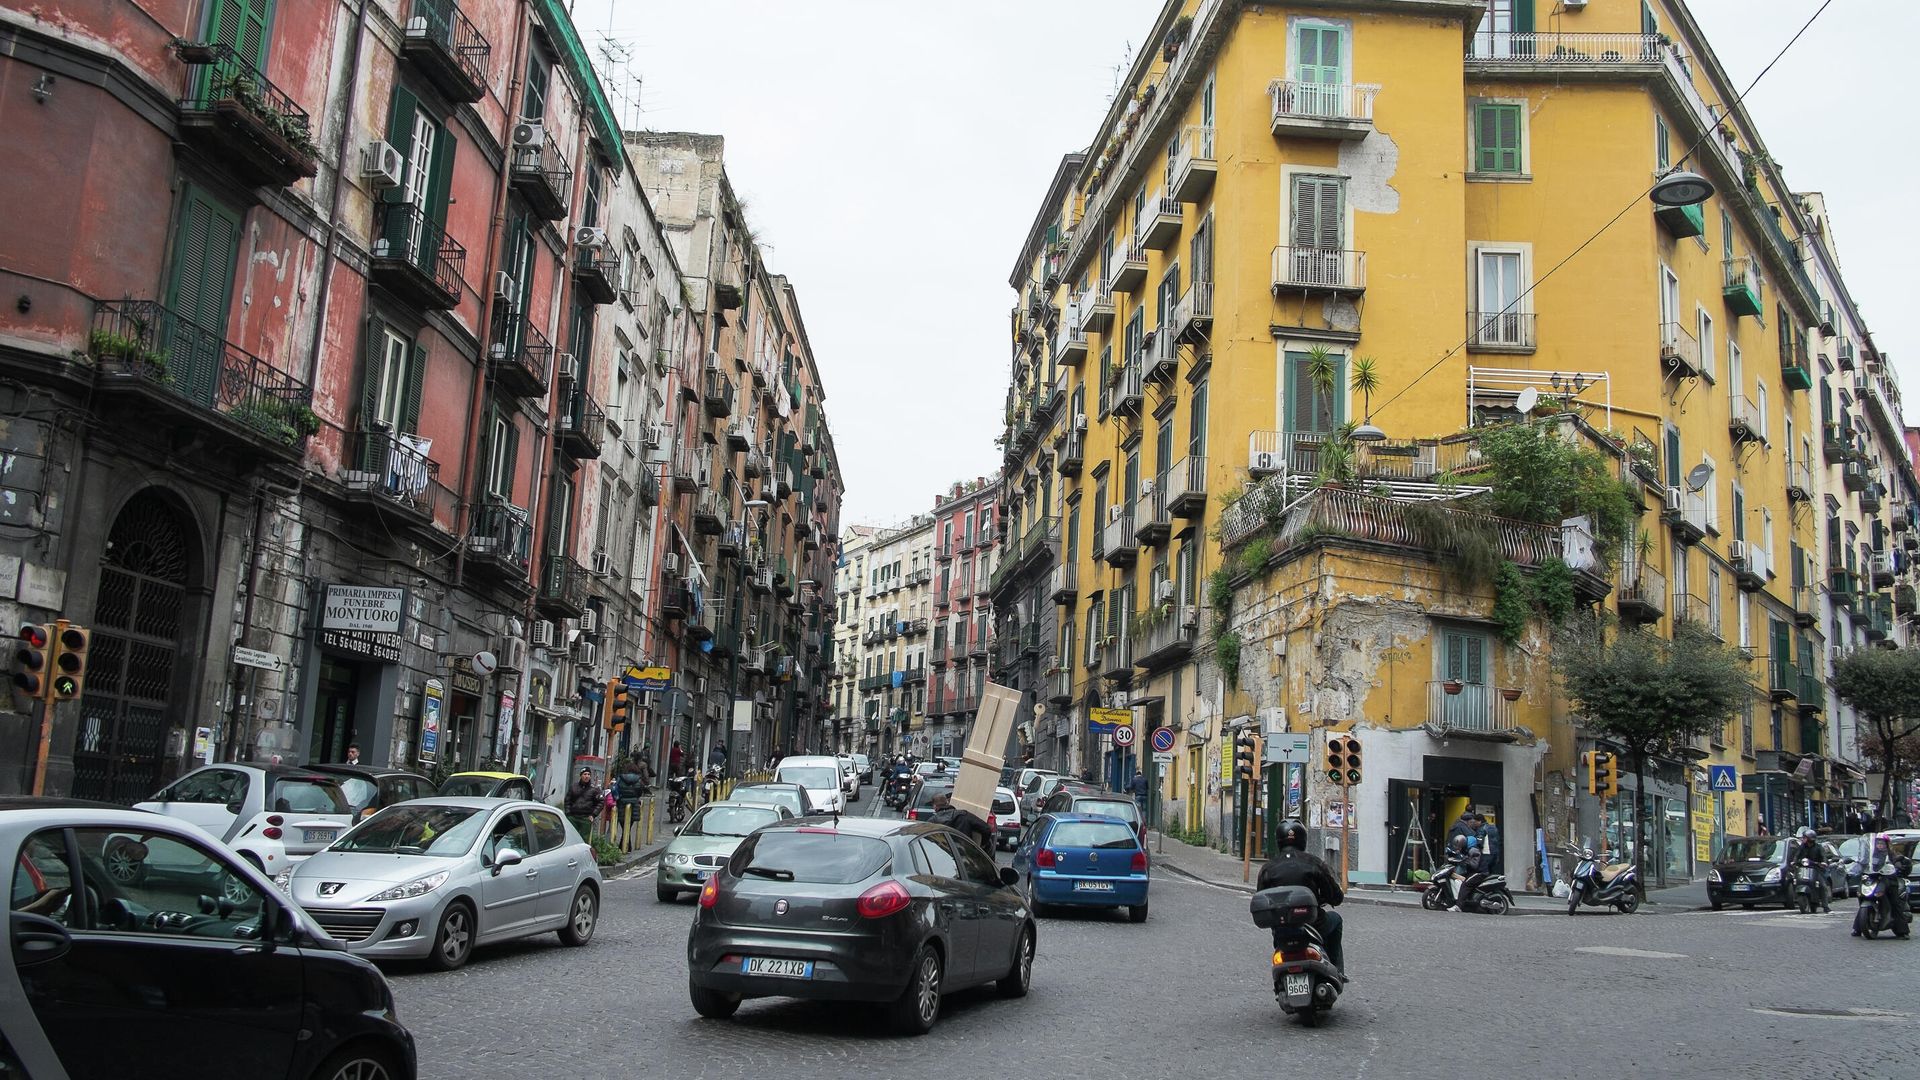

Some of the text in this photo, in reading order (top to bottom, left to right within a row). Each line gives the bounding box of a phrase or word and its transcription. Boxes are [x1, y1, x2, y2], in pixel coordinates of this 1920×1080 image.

[328, 587, 402, 600] PRIMARIA IMPRESA
[343, 598, 386, 608] FUNEBRE
[326, 606, 398, 623] MONTUORO
[324, 632, 337, 646] TEL
[339, 636, 370, 654] 5640892
[455, 673, 480, 692] MUSEO
[1118, 730, 1131, 740] 30
[750, 959, 805, 975] DK 221XB
[1288, 983, 1309, 994] 9609
